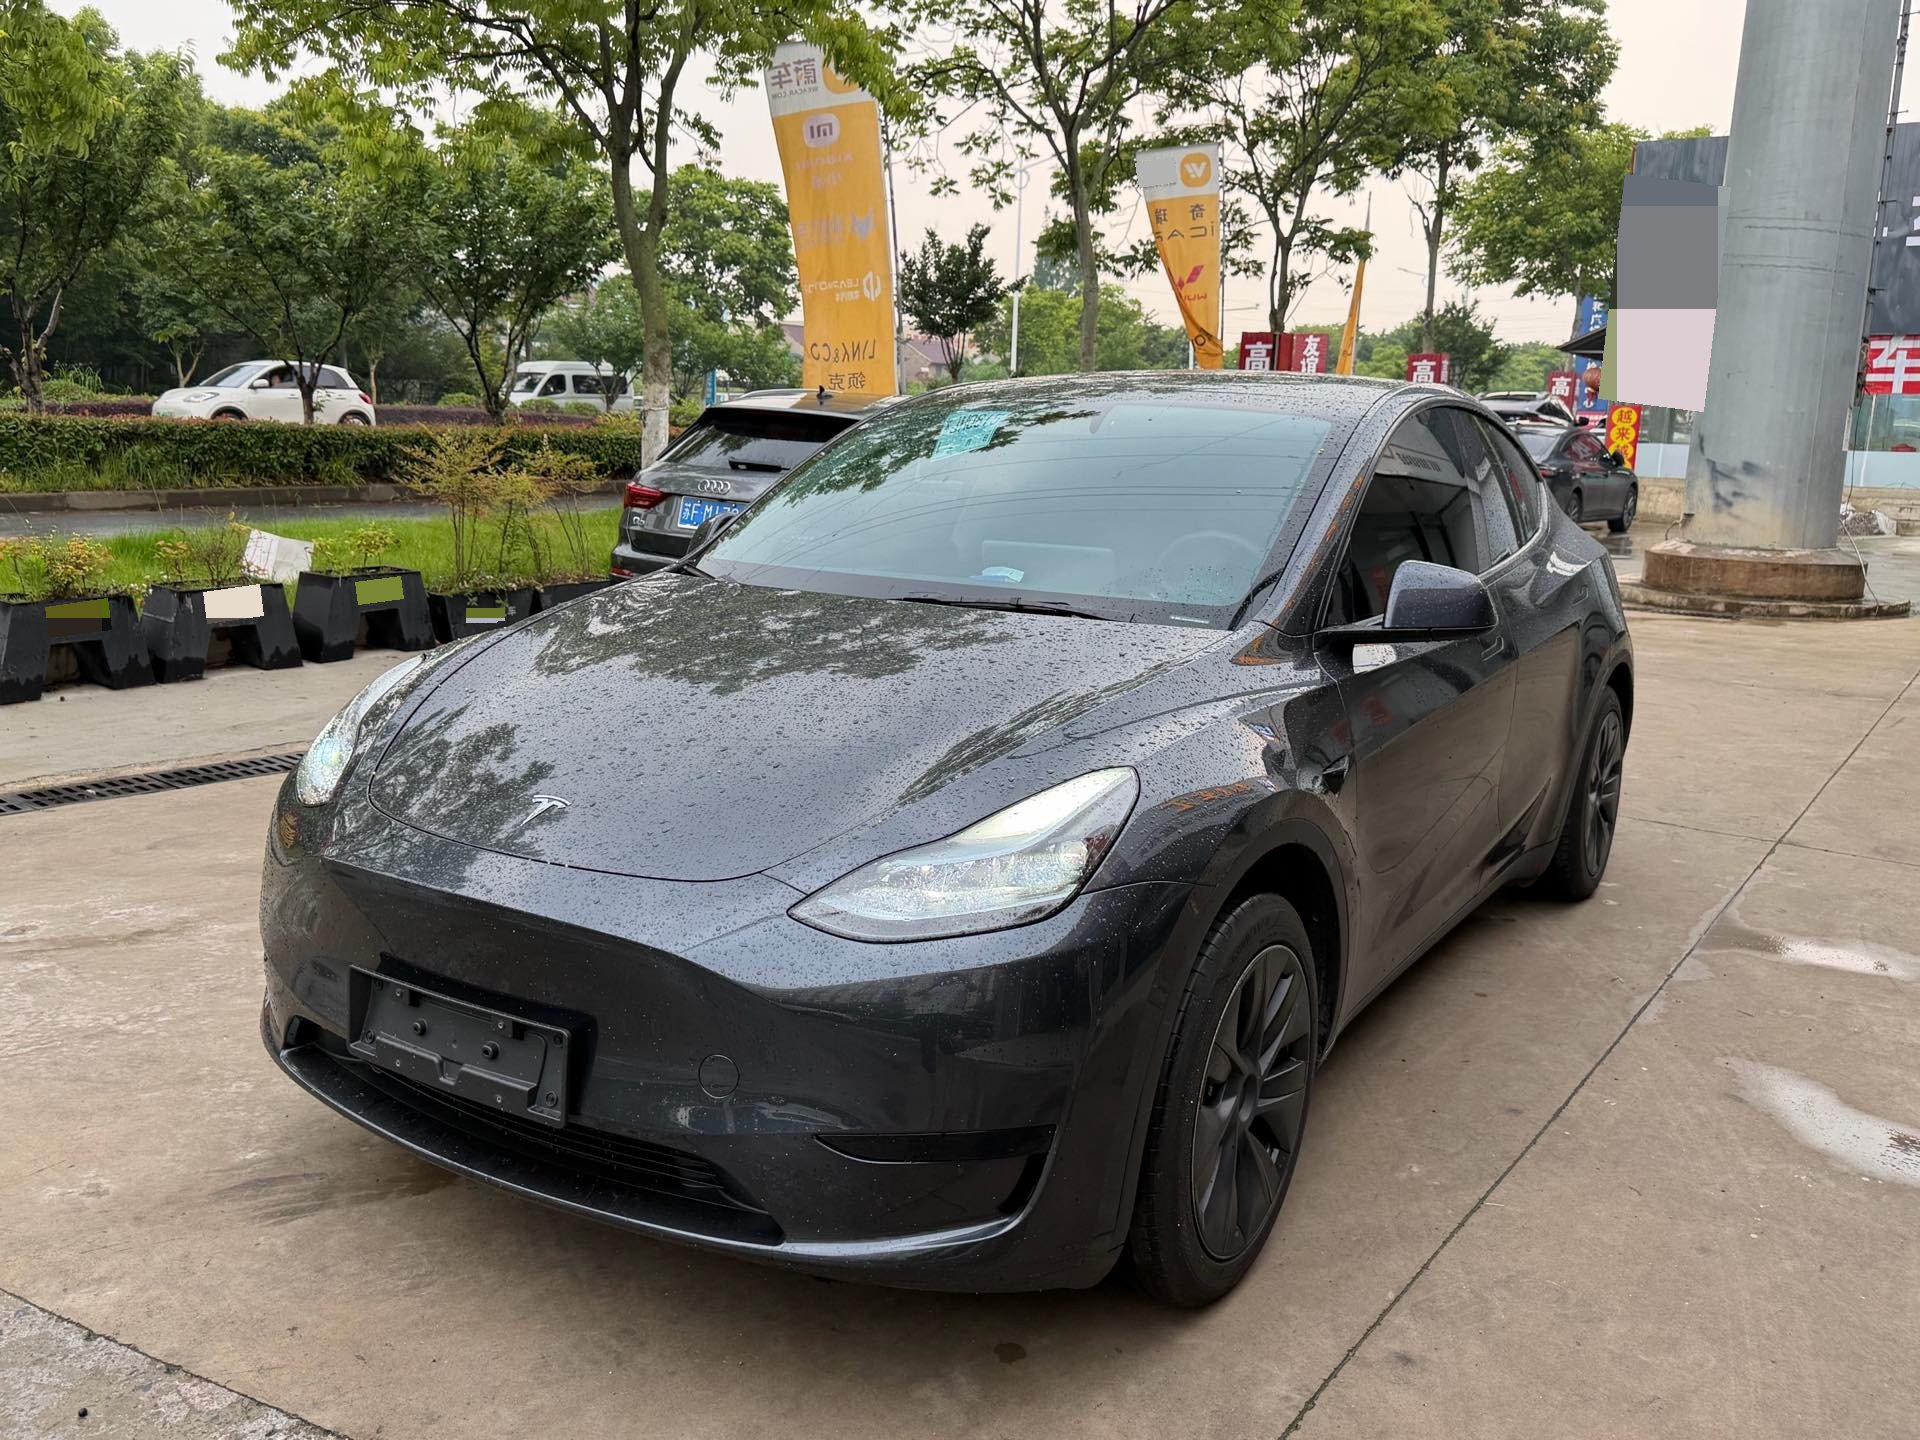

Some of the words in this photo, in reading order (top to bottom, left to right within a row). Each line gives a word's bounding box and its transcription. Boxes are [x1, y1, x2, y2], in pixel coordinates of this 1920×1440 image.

[1244, 341, 1272, 371] 高
[1412, 359, 1436, 383] 高
[1552, 377, 1572, 397] 高
